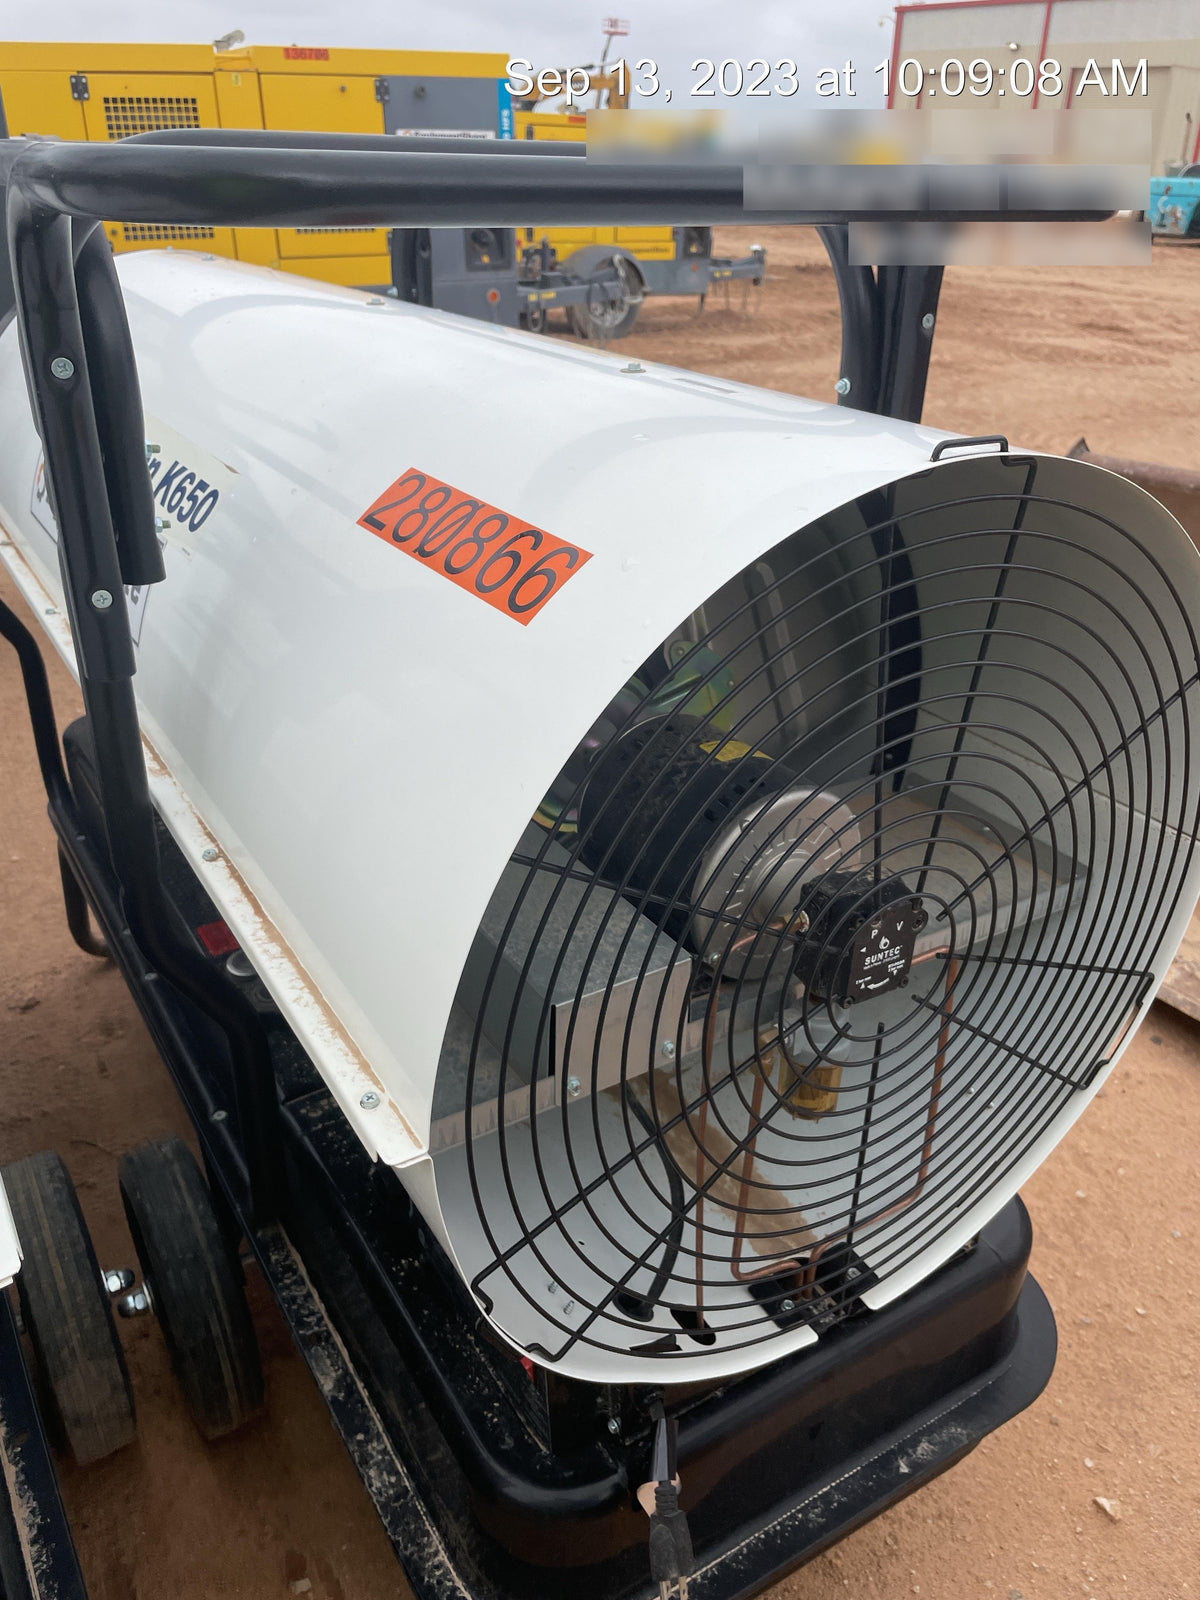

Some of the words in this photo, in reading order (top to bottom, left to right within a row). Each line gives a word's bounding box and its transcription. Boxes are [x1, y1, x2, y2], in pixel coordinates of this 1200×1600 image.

[152, 460, 220, 534] K650
[362, 474, 580, 614] 280866
[871, 929, 878, 939] P
[896, 920, 903, 931] V
[864, 946, 900, 965] SUNTEC
